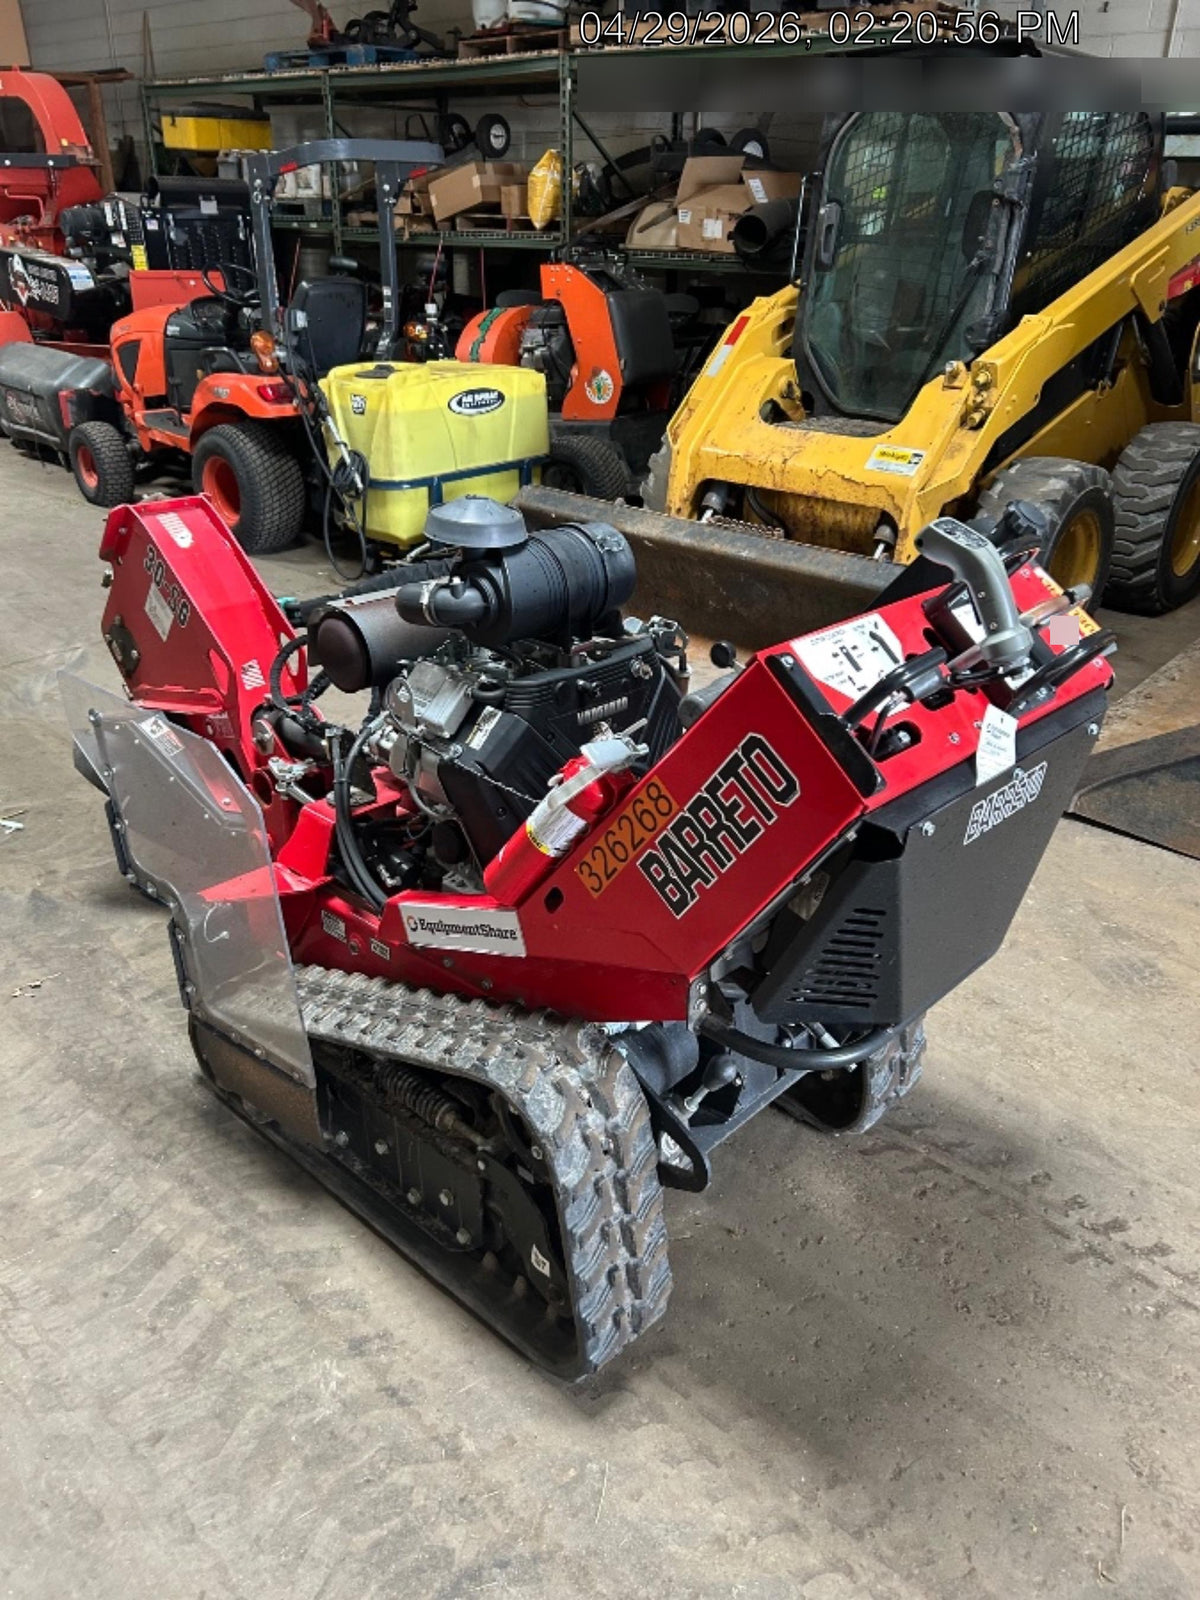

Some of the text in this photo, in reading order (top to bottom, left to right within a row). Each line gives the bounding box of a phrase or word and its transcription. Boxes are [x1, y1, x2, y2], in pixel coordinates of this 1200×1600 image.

[578, 781, 674, 894] 326268
[636, 732, 802, 920] BARRETO
[963, 760, 1048, 846] BARRETO
[418, 917, 519, 941] EquipmentShare
